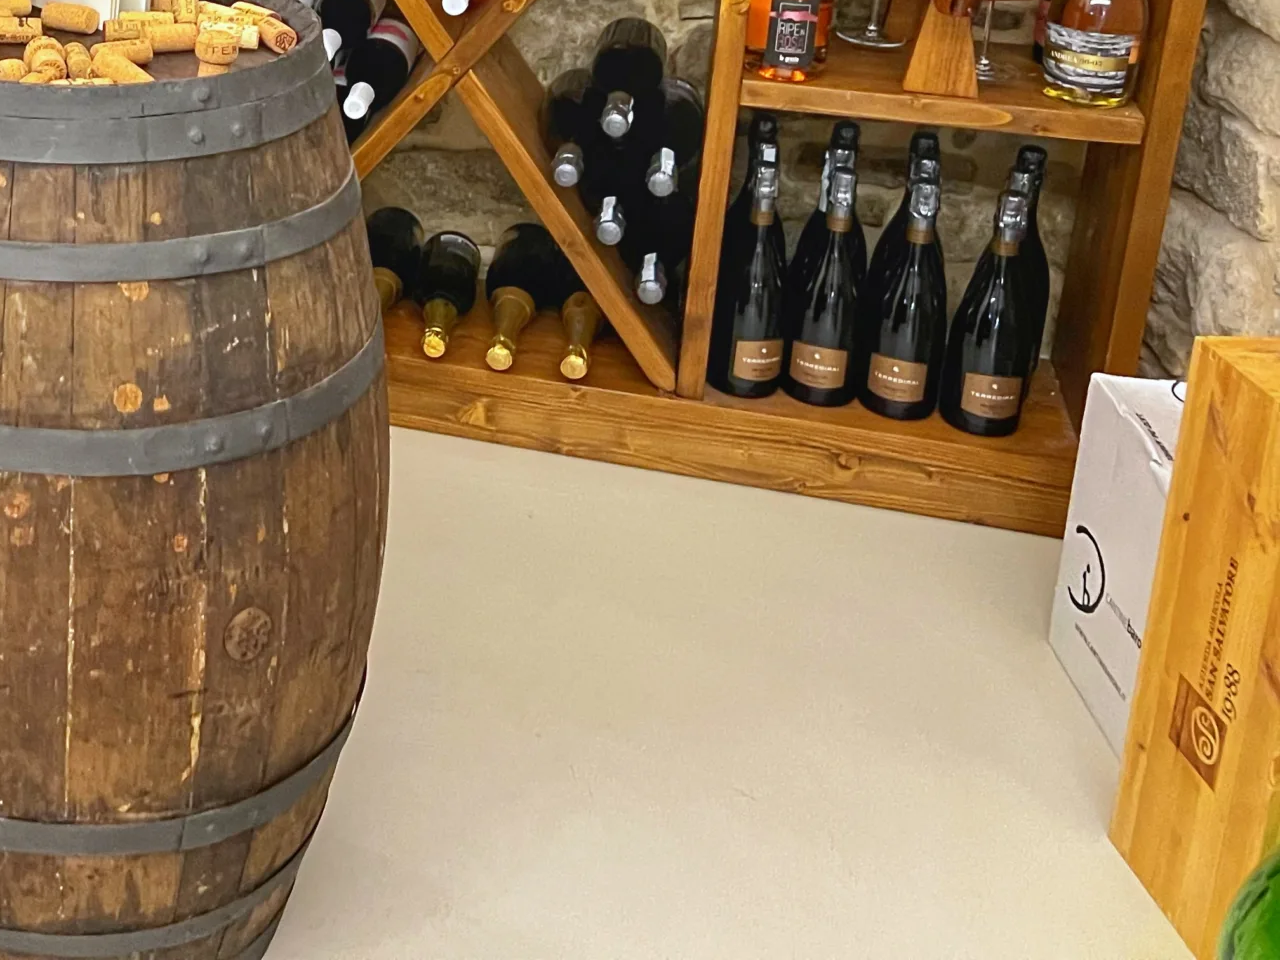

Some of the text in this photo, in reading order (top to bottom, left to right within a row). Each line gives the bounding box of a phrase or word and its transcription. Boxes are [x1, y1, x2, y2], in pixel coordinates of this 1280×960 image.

[779, 21, 801, 37] RIPE
[1205, 556, 1239, 702] SAN SALVATORE
